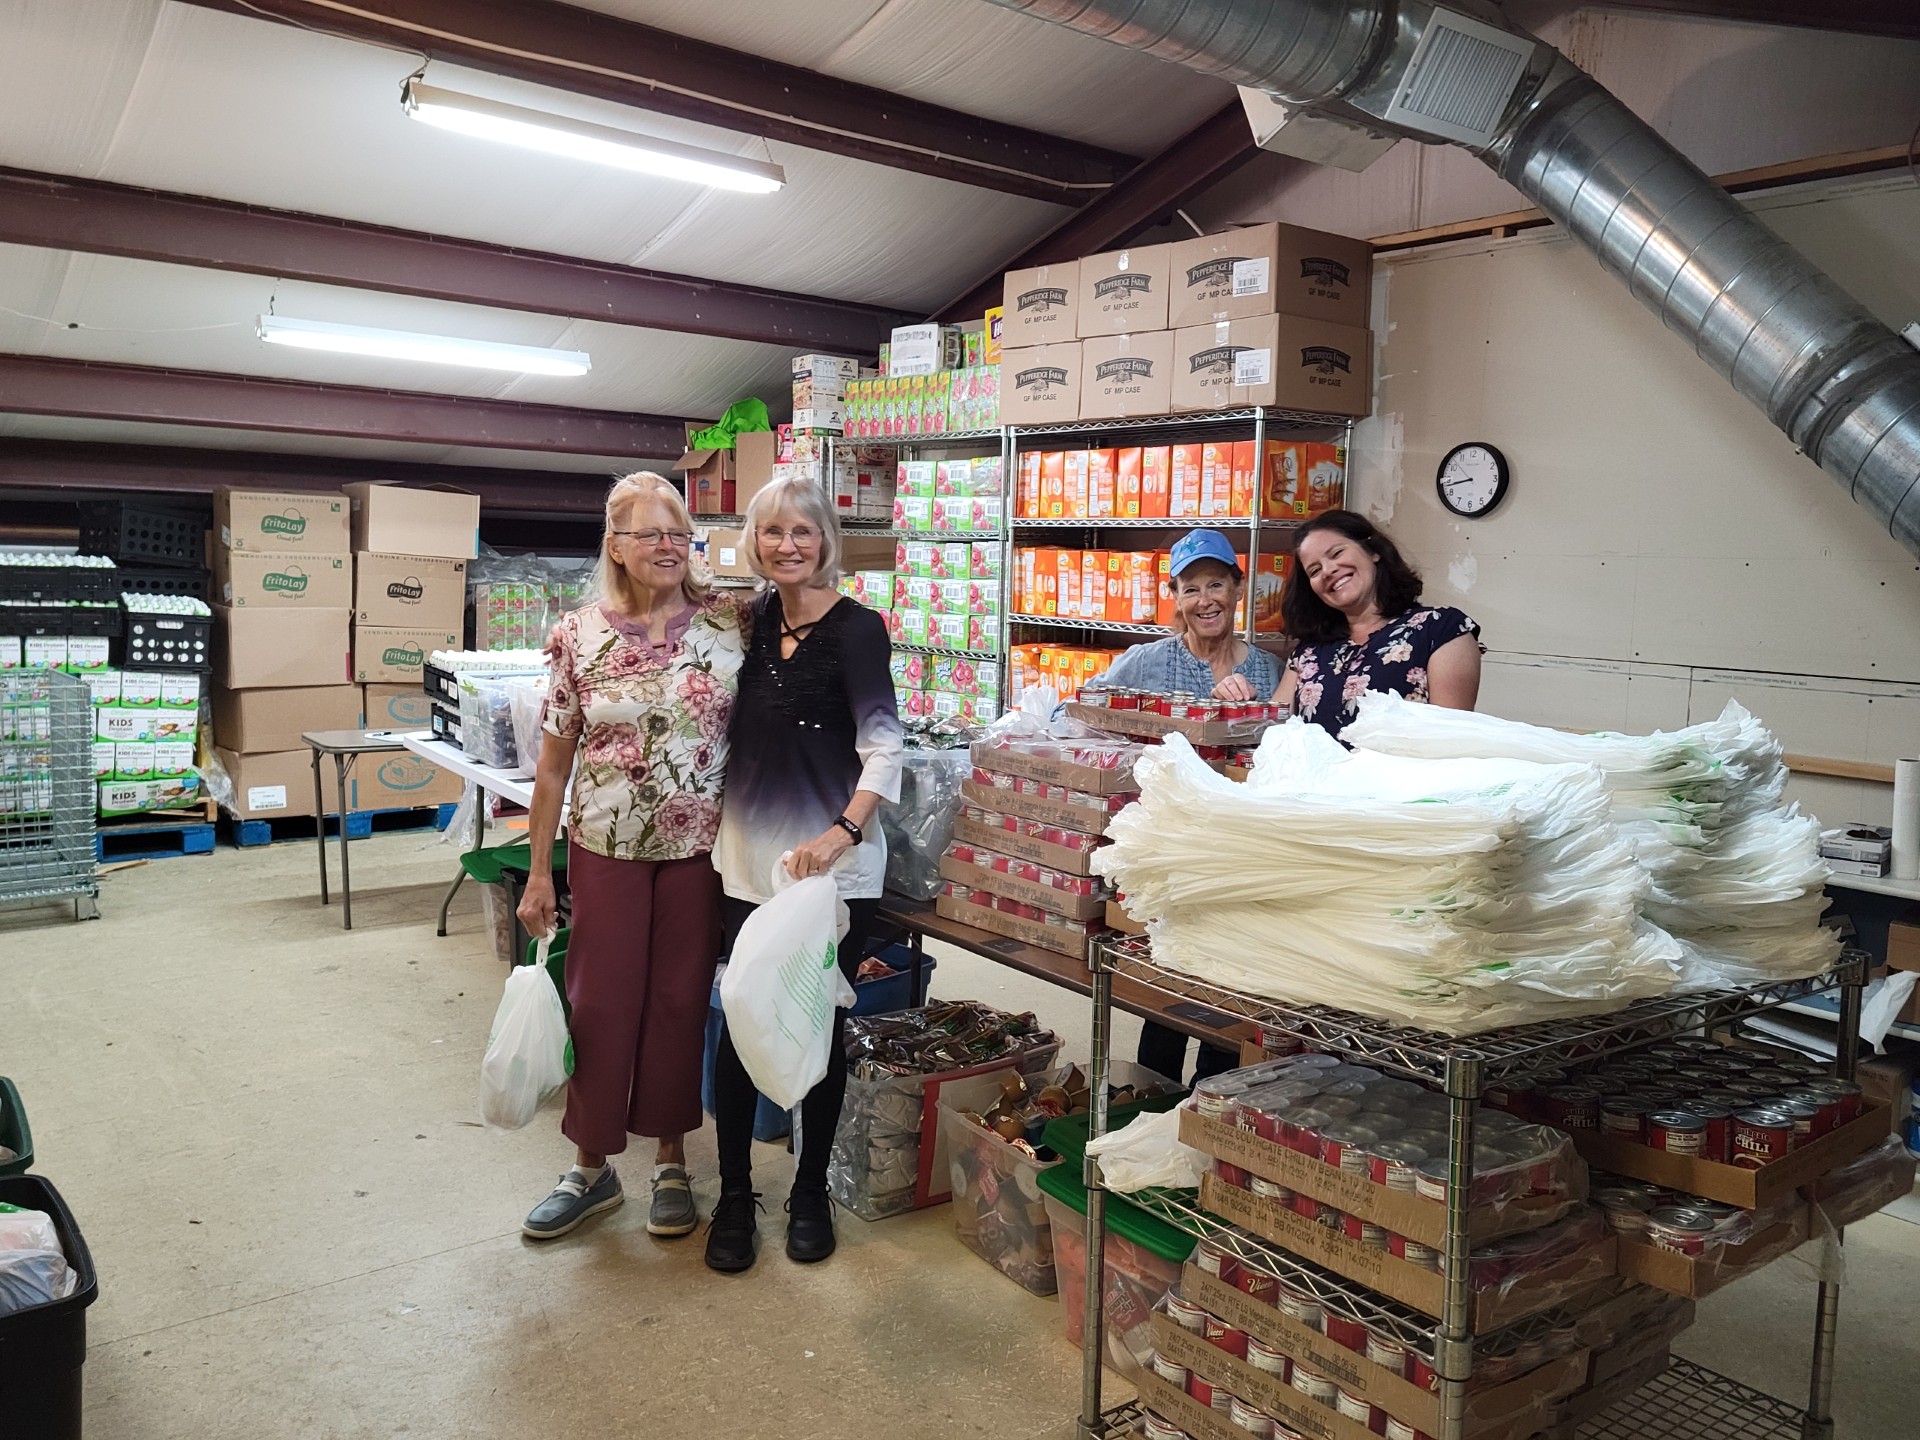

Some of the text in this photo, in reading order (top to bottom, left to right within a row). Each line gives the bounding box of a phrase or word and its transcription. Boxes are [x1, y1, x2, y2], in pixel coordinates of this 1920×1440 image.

[1197, 292, 1207, 300] GF
[1221, 288, 1233, 297] CAS
[1123, 301, 1139, 310] CASE
[1042, 314, 1057, 322] CASE
[1200, 379, 1209, 387] GF
[1212, 377, 1222, 385] MP
[109, 719, 133, 727] KIDS
[112, 791, 137, 800] KIDS
[1563, 1118, 1597, 1128] CHILI
[1735, 1135, 1770, 1153] CHILI
[1284, 1149, 1304, 1167] CHILI
[1318, 1162, 1346, 1184] BEANS
[1290, 1211, 1310, 1230] CHILI
